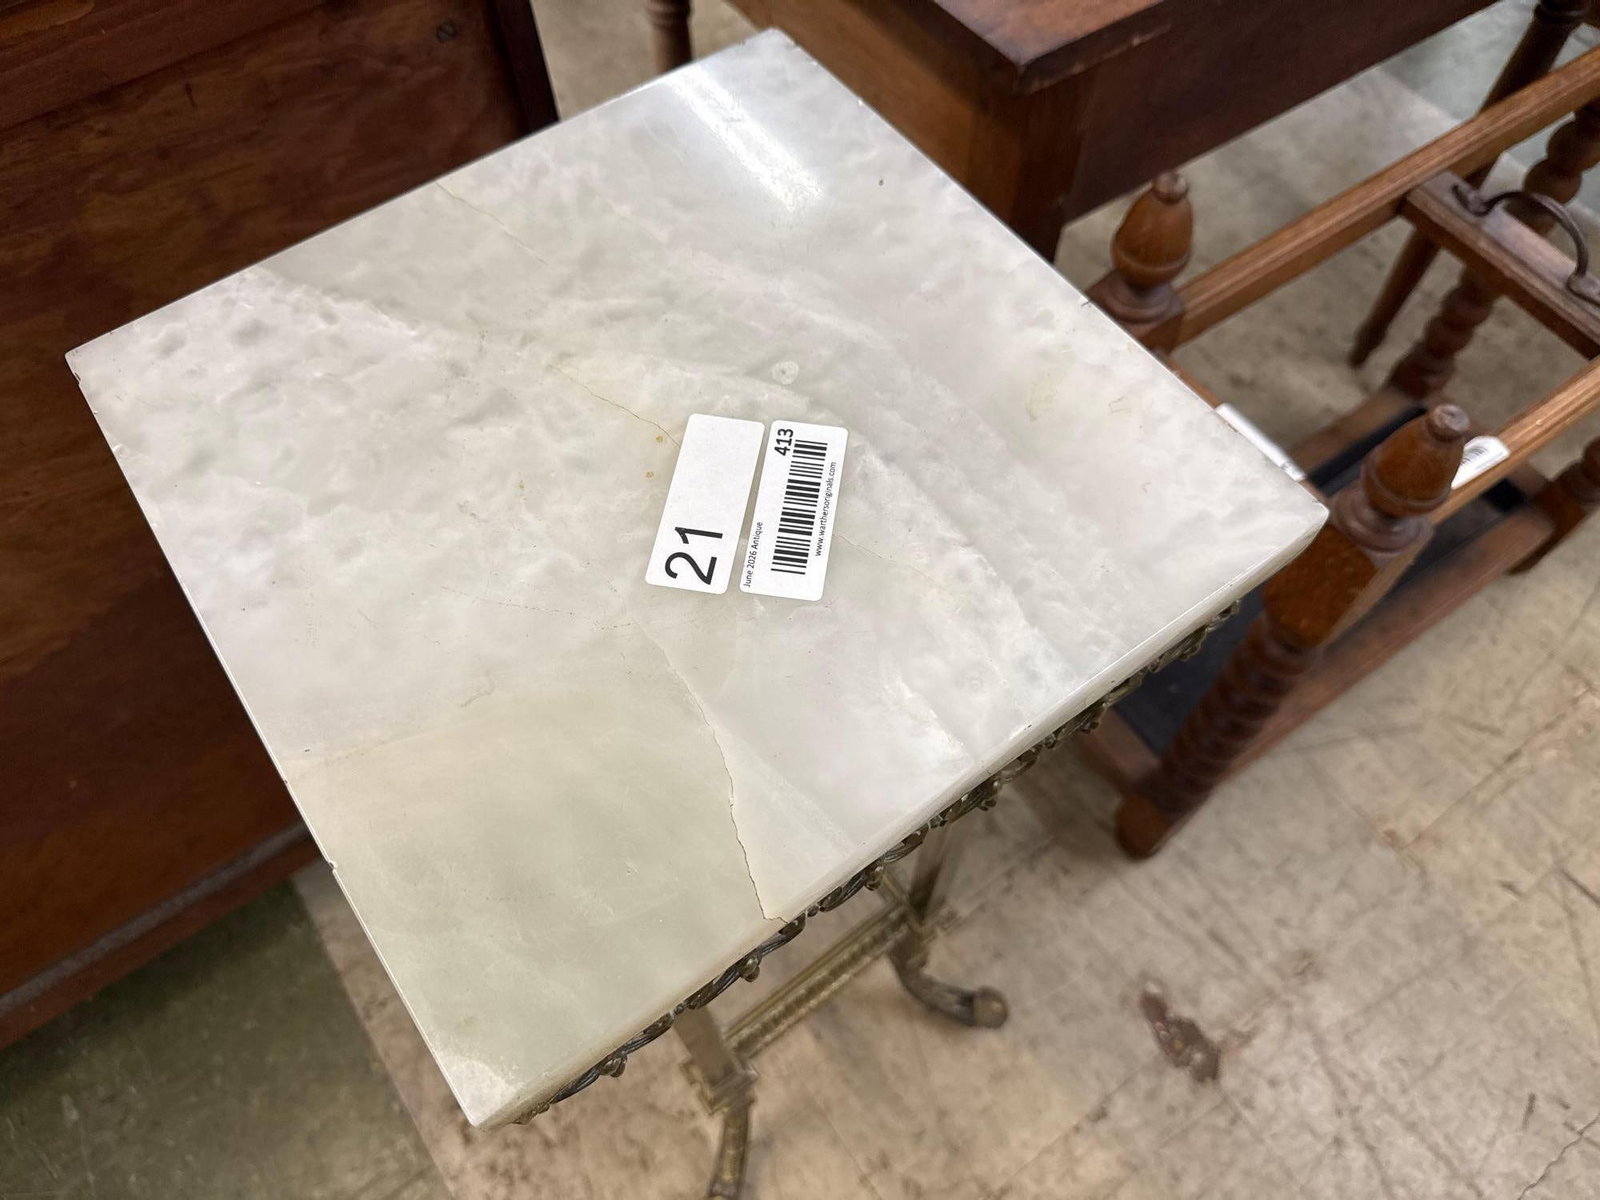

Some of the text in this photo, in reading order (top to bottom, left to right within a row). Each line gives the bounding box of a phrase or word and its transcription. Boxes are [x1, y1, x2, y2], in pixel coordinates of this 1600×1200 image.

[774, 428, 794, 456] 413
[815, 461, 836, 557] www.warthersoriginals.com
[664, 526, 723, 586] 21
[743, 521, 763, 588] June 2026 Antique
